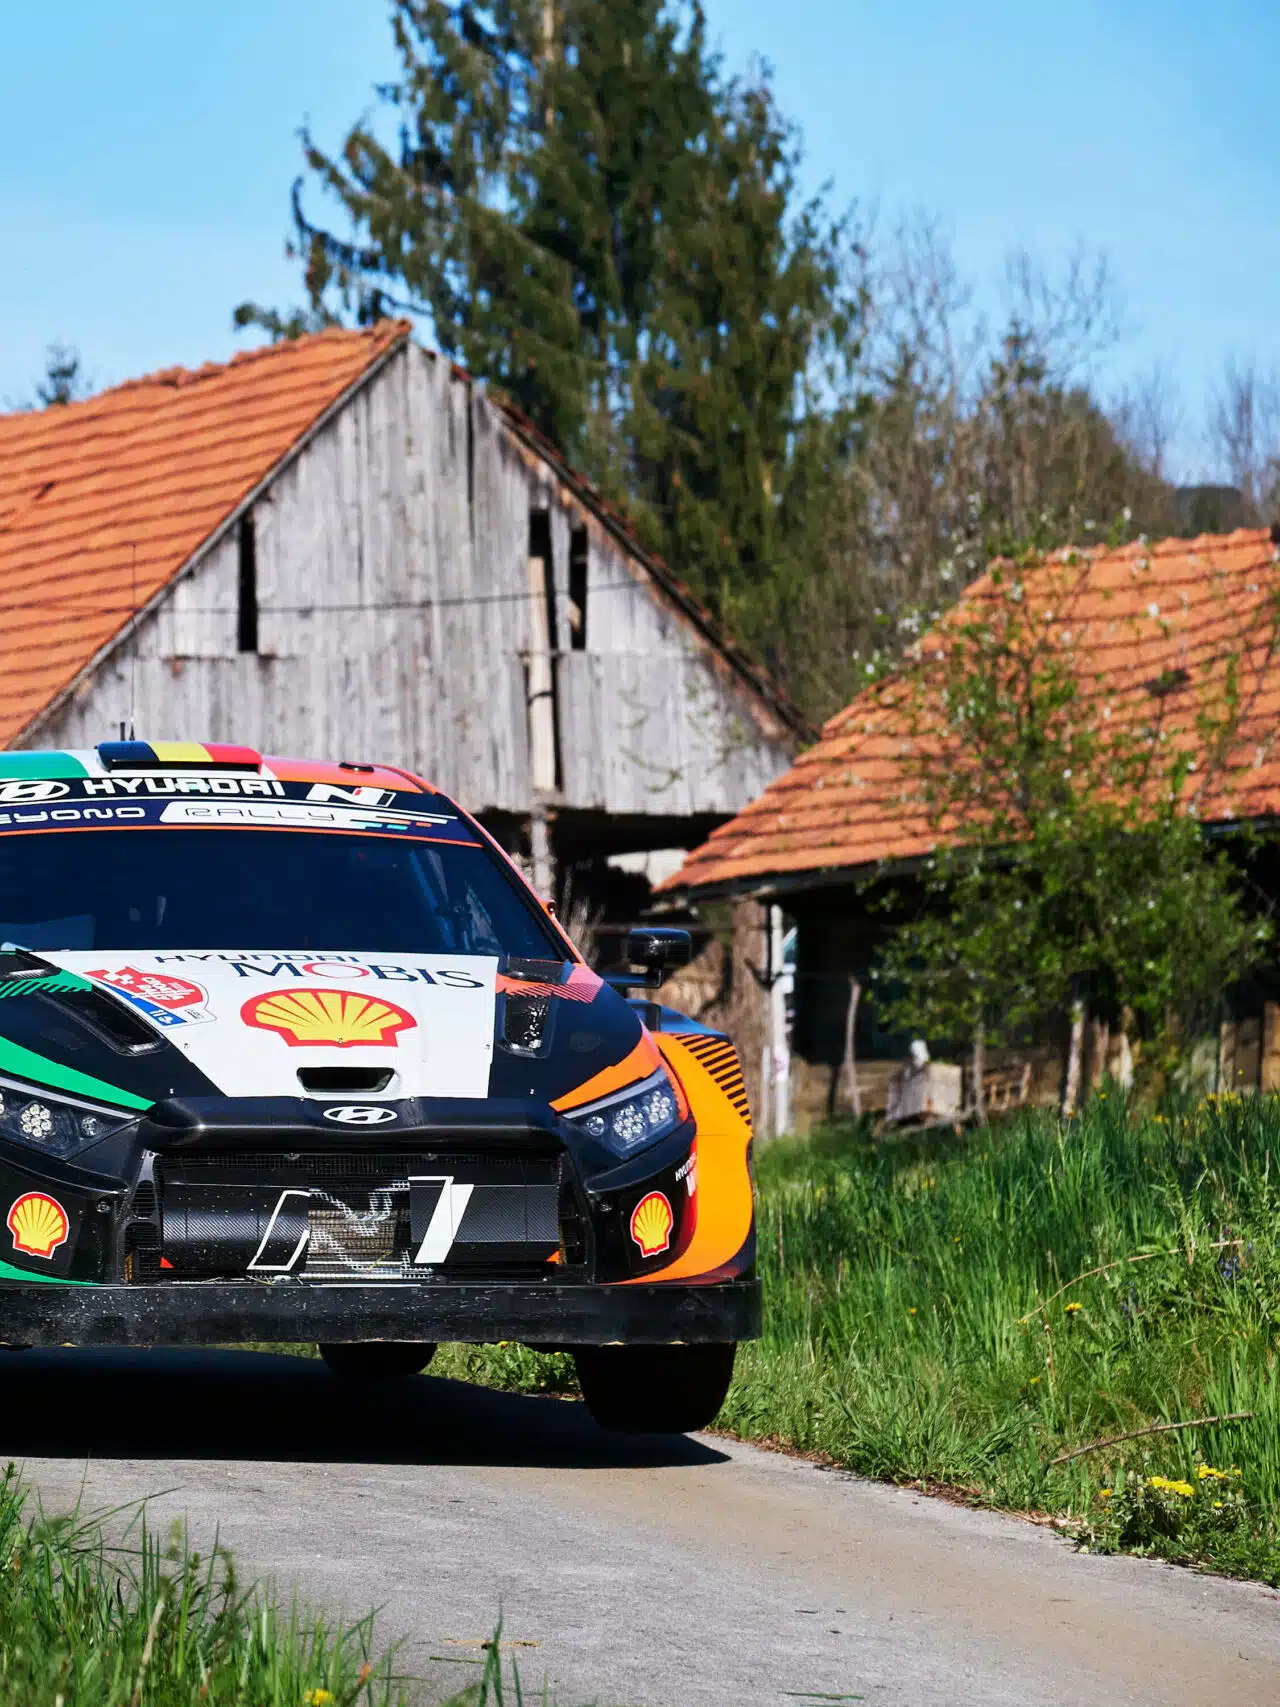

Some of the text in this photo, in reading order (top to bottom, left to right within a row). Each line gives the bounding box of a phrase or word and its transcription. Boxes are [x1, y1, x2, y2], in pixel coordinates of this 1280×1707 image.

[81, 777, 286, 796] HYUNDAI
[184, 807, 336, 822] RALLY
[154, 953, 361, 963] HYUNDAI
[230, 962, 485, 988] MOBIS
